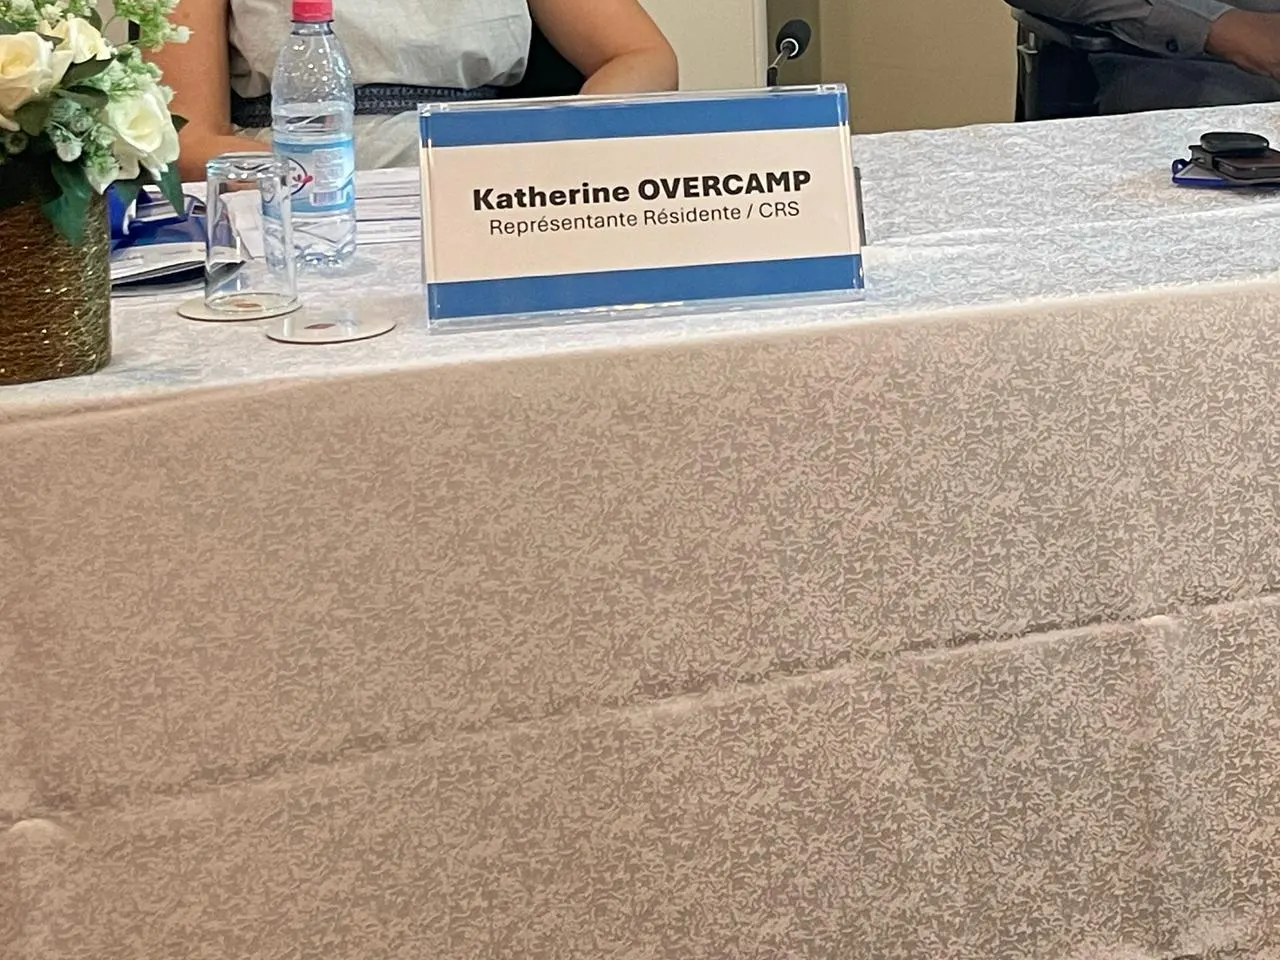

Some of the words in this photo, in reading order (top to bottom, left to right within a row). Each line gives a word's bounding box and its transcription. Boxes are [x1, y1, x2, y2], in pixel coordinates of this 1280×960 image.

[473, 182, 630, 211] Katherine
[637, 170, 812, 201] OVERCAMP
[489, 213, 638, 237] Représentante
[643, 205, 742, 226] Résidente
[746, 204, 754, 219] /
[758, 201, 801, 218] CRS
